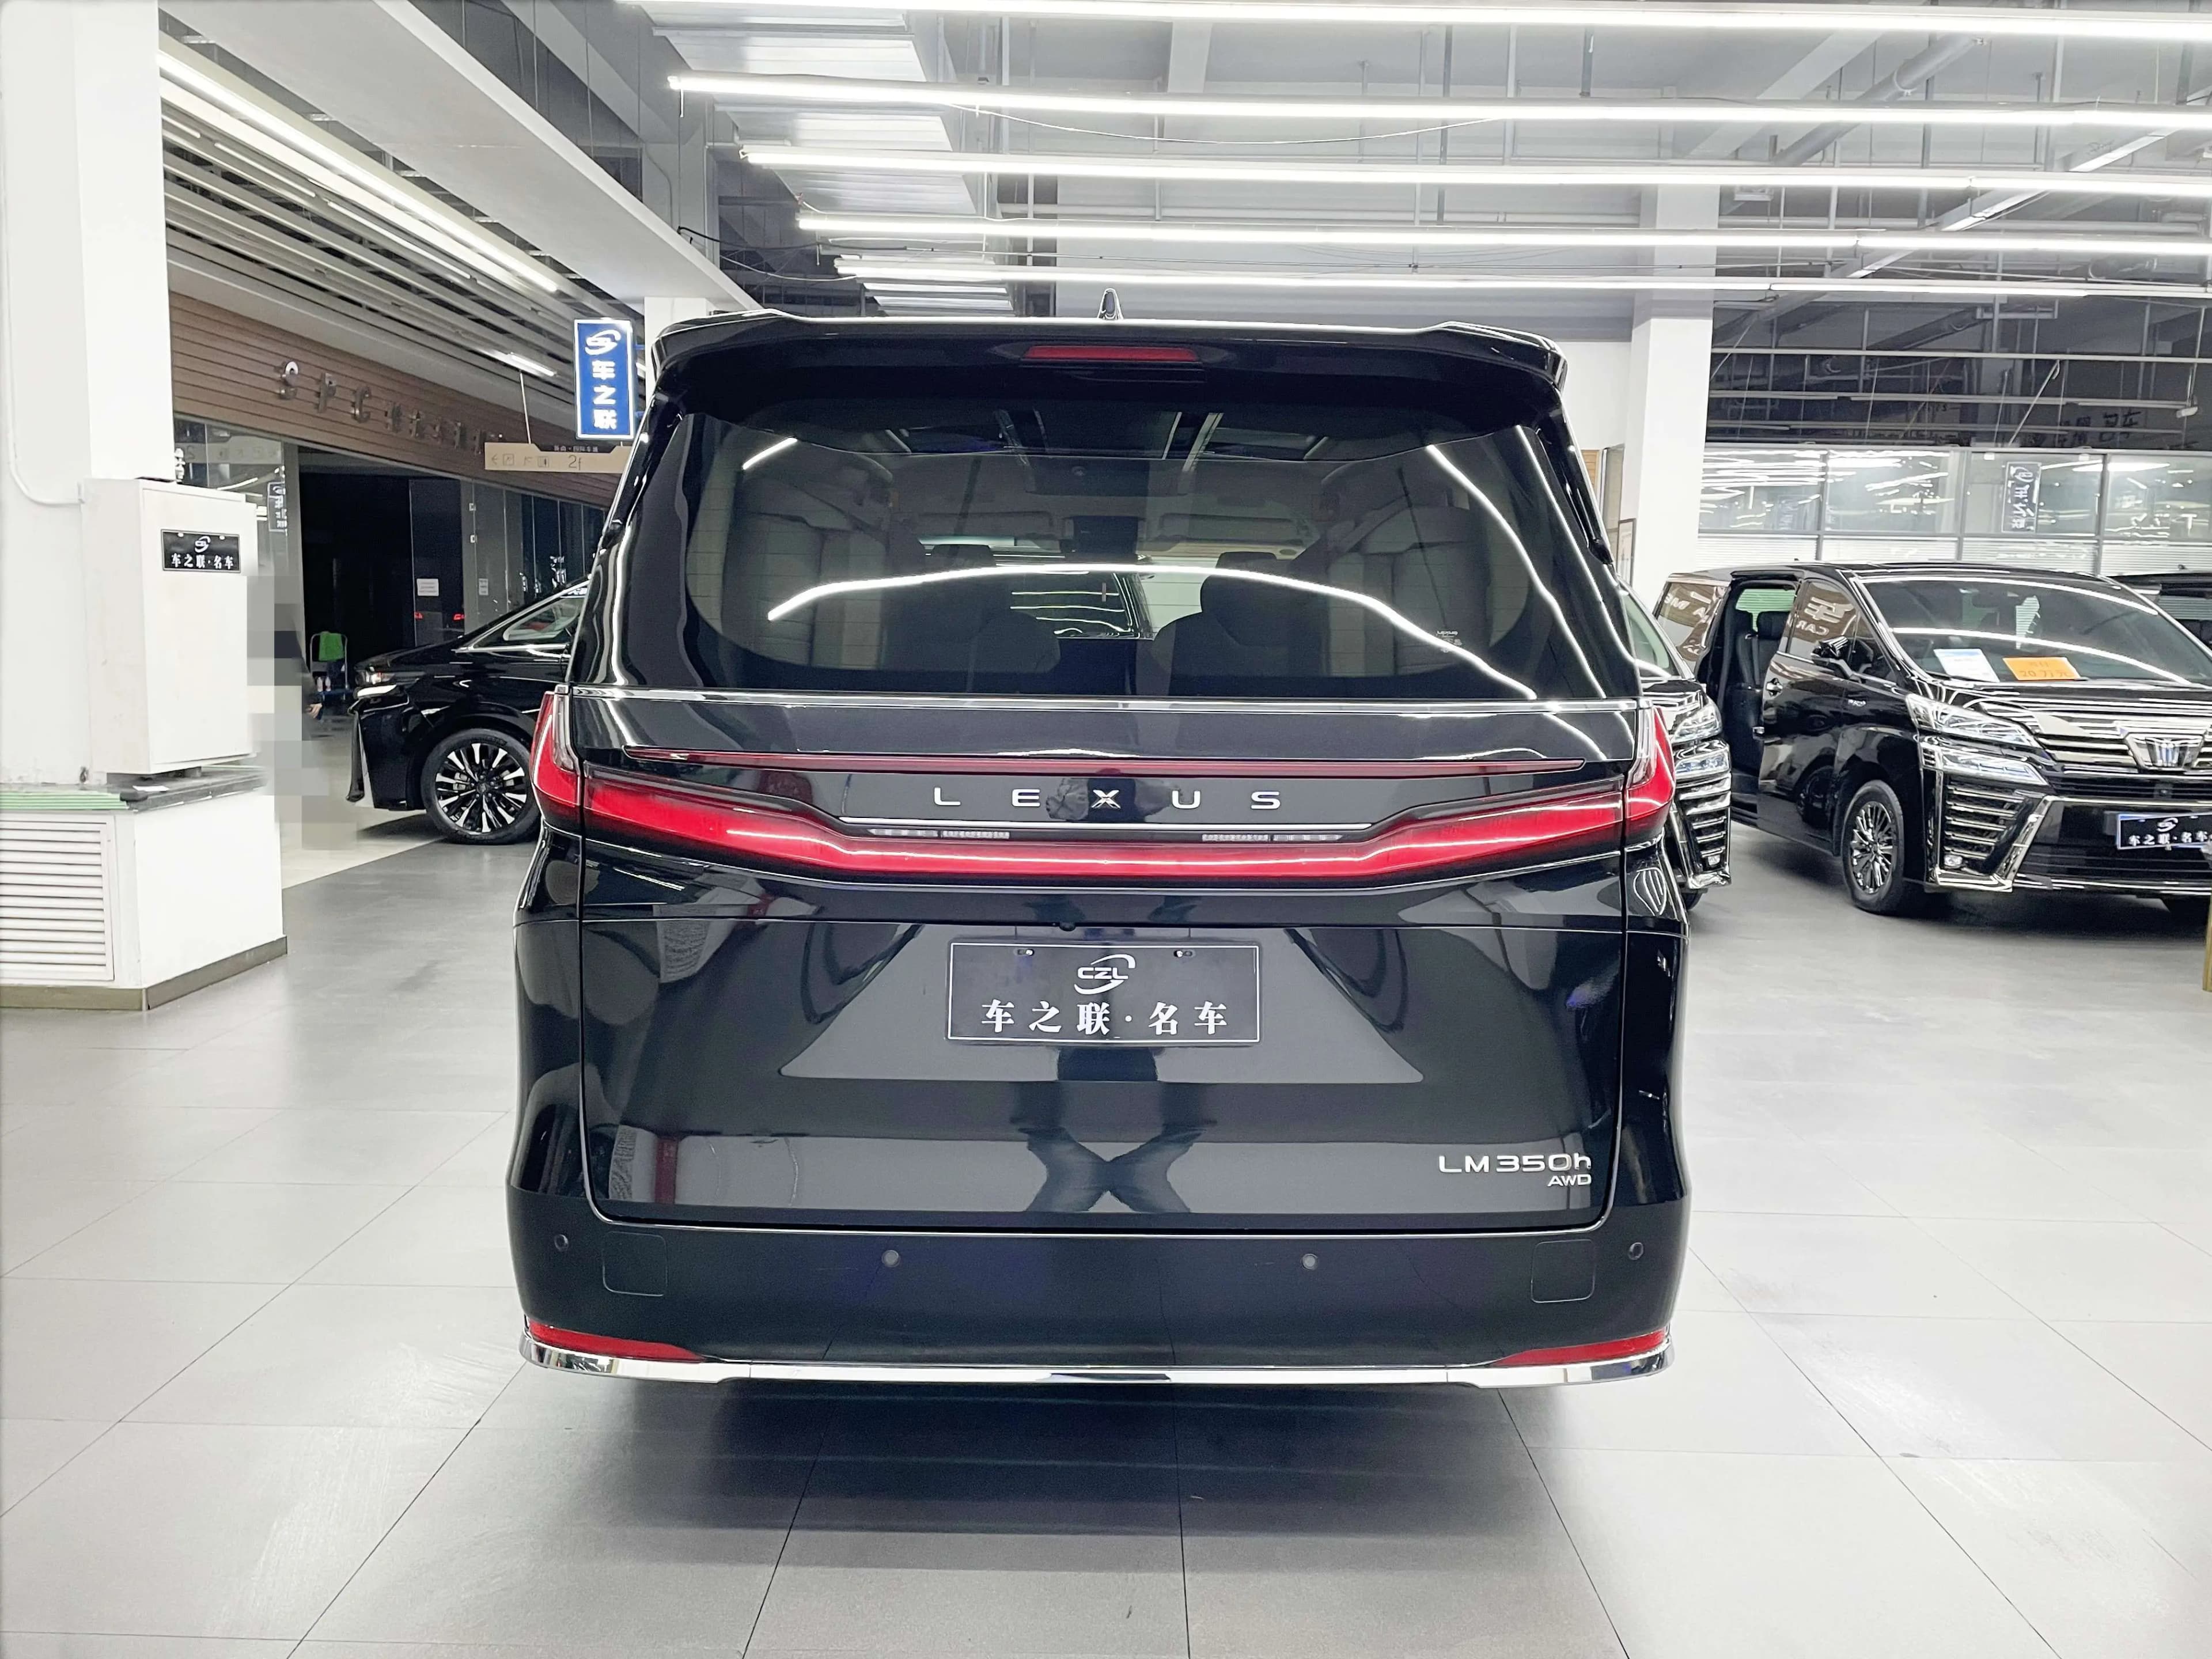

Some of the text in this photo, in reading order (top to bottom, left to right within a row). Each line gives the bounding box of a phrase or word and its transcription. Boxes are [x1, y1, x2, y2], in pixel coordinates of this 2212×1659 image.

[592, 359, 618, 430] 车之联
[934, 787, 1281, 810] LEXUS
[1077, 967, 1130, 980] CZL
[981, 998, 1227, 1036] 车之联·名车
[1547, 1174, 1592, 1187] AWD
